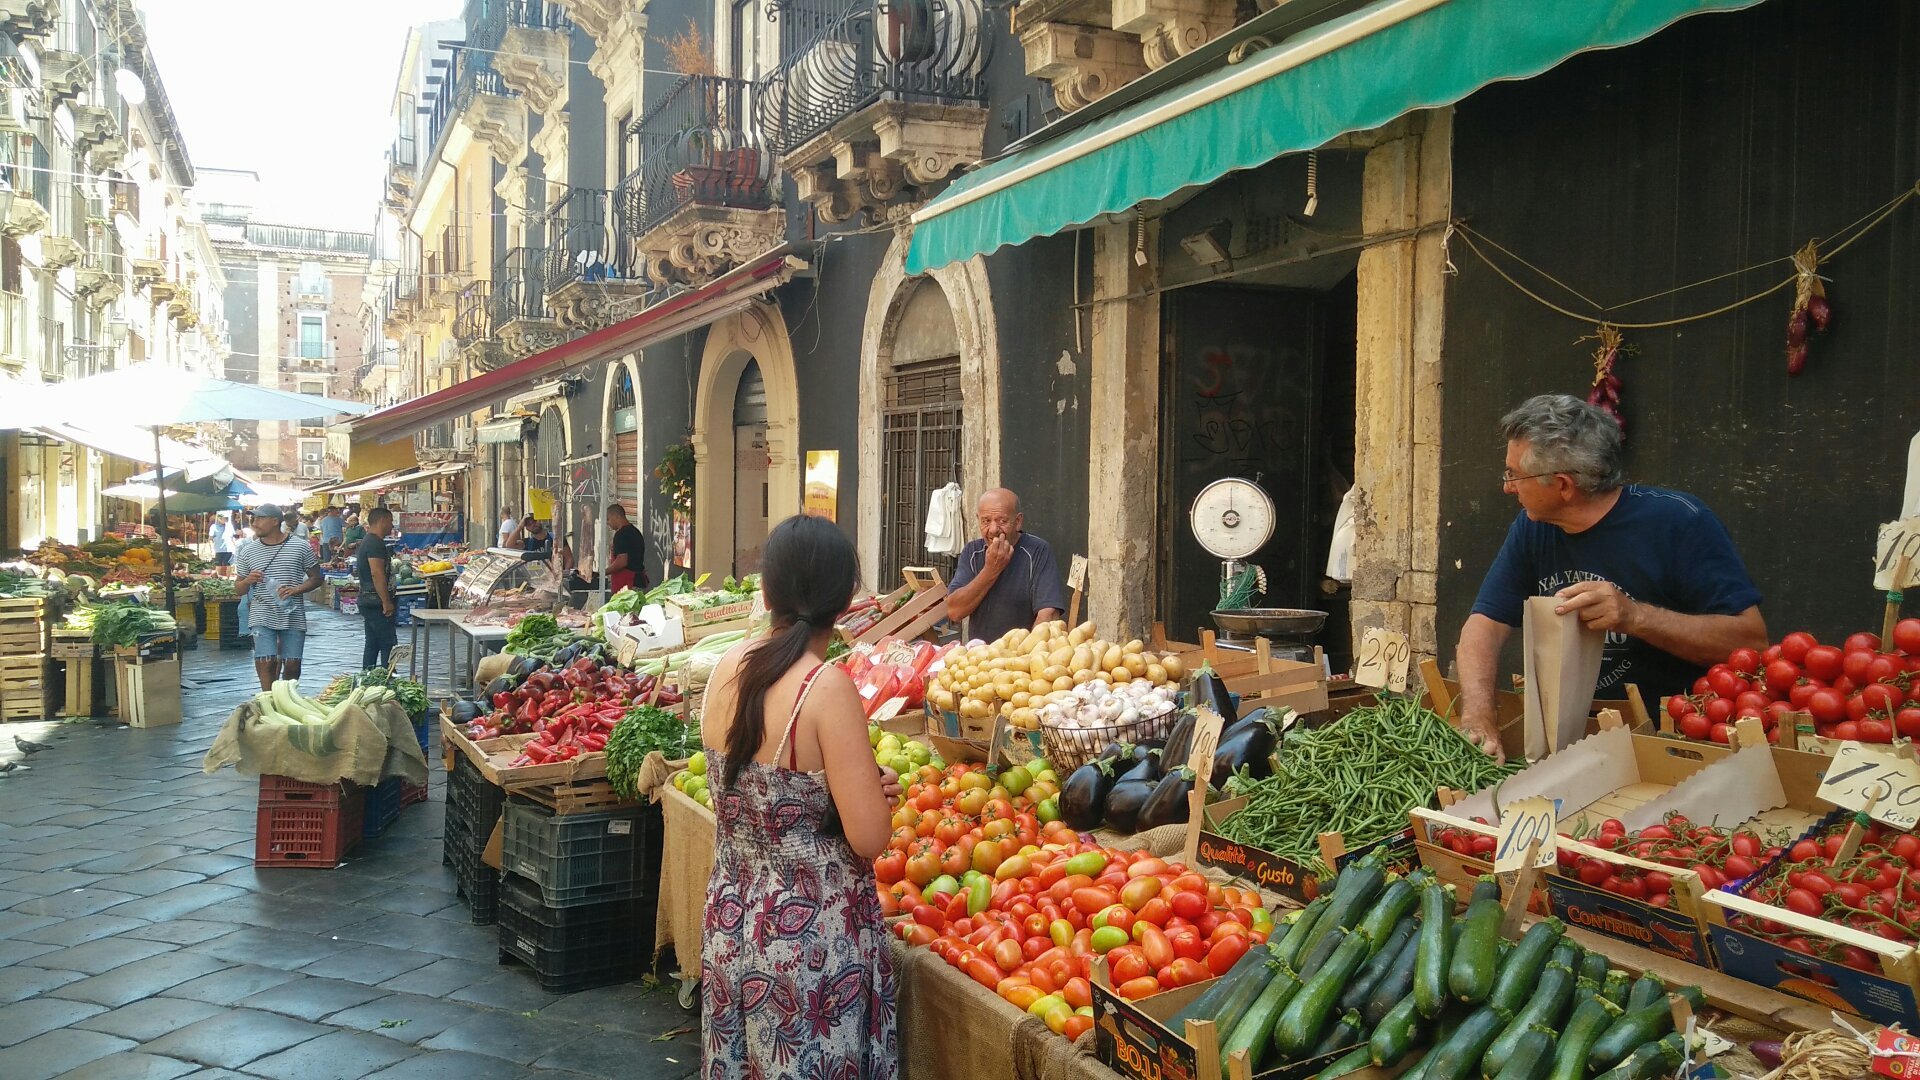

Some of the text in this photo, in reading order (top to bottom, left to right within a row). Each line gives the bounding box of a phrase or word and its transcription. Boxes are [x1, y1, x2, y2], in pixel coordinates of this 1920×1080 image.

[1362, 637, 1408, 671] 2,00
[1496, 810, 1550, 860] 1,00
[1200, 841, 1246, 866] Qualità
[1257, 862, 1294, 886] Gusto
